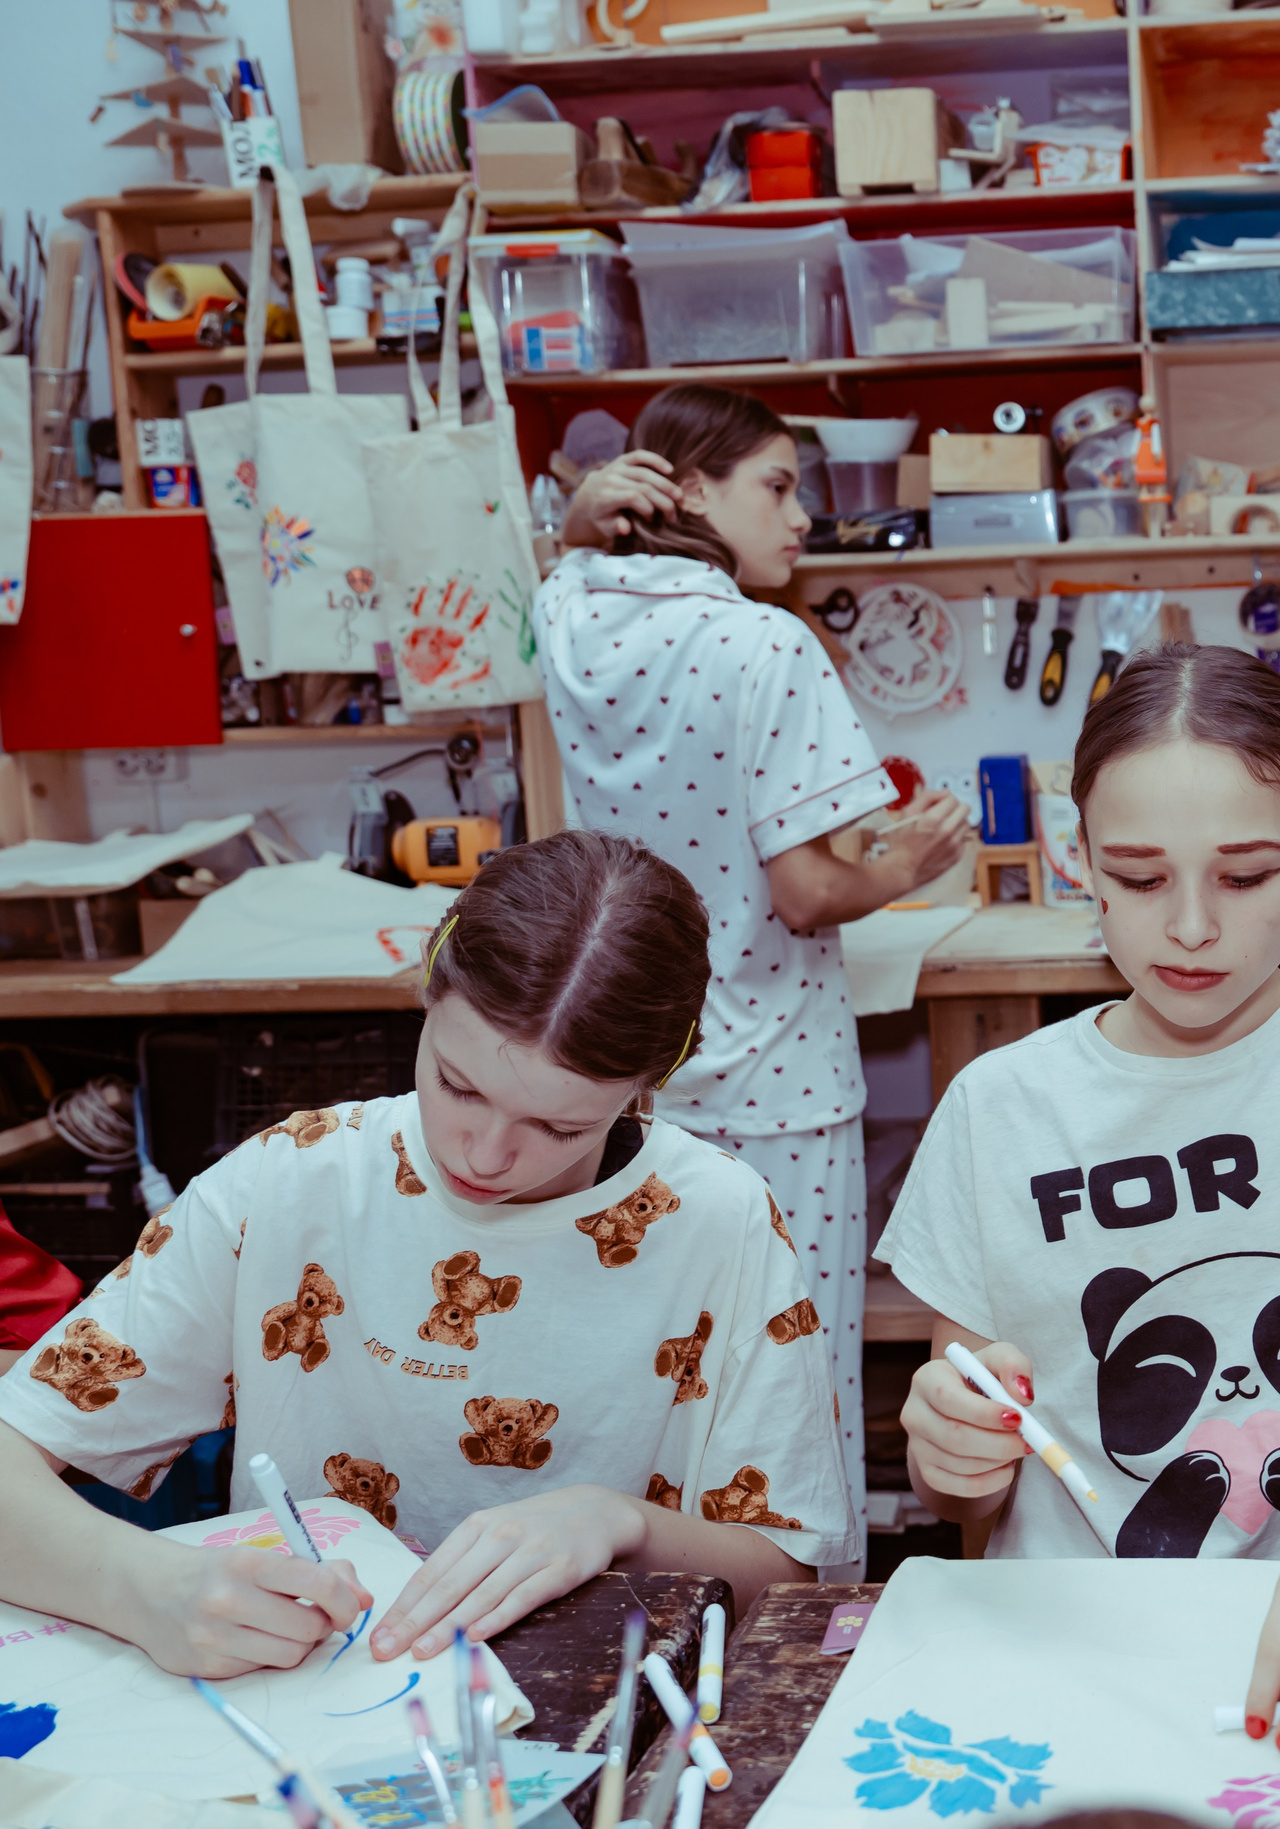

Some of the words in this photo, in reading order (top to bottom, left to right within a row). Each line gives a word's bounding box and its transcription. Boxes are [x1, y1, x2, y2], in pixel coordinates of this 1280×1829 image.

[326, 590, 382, 611] LOVE
[1030, 1133, 1262, 1243] FOR
[364, 1337, 397, 1366] DAY
[401, 1356, 469, 1380] BETTER
